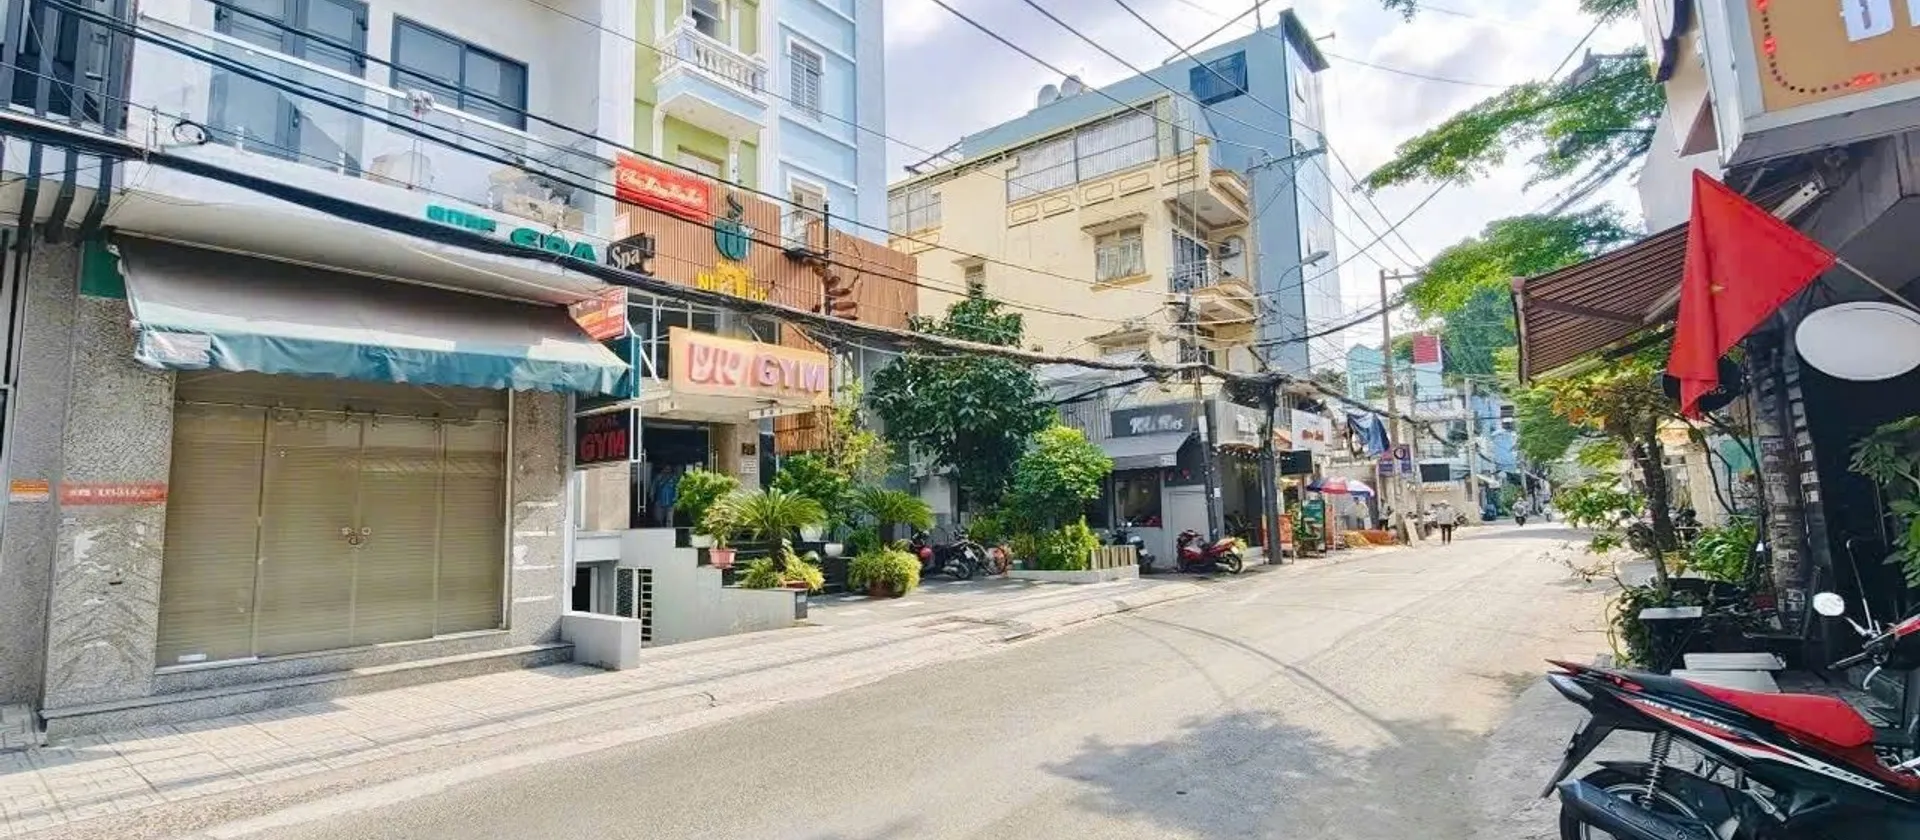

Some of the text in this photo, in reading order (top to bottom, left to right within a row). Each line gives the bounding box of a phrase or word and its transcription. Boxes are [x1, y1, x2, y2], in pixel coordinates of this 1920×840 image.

[612, 246, 640, 269] Spa
[755, 353, 825, 393] GYM
[580, 430, 625, 461] GYM
